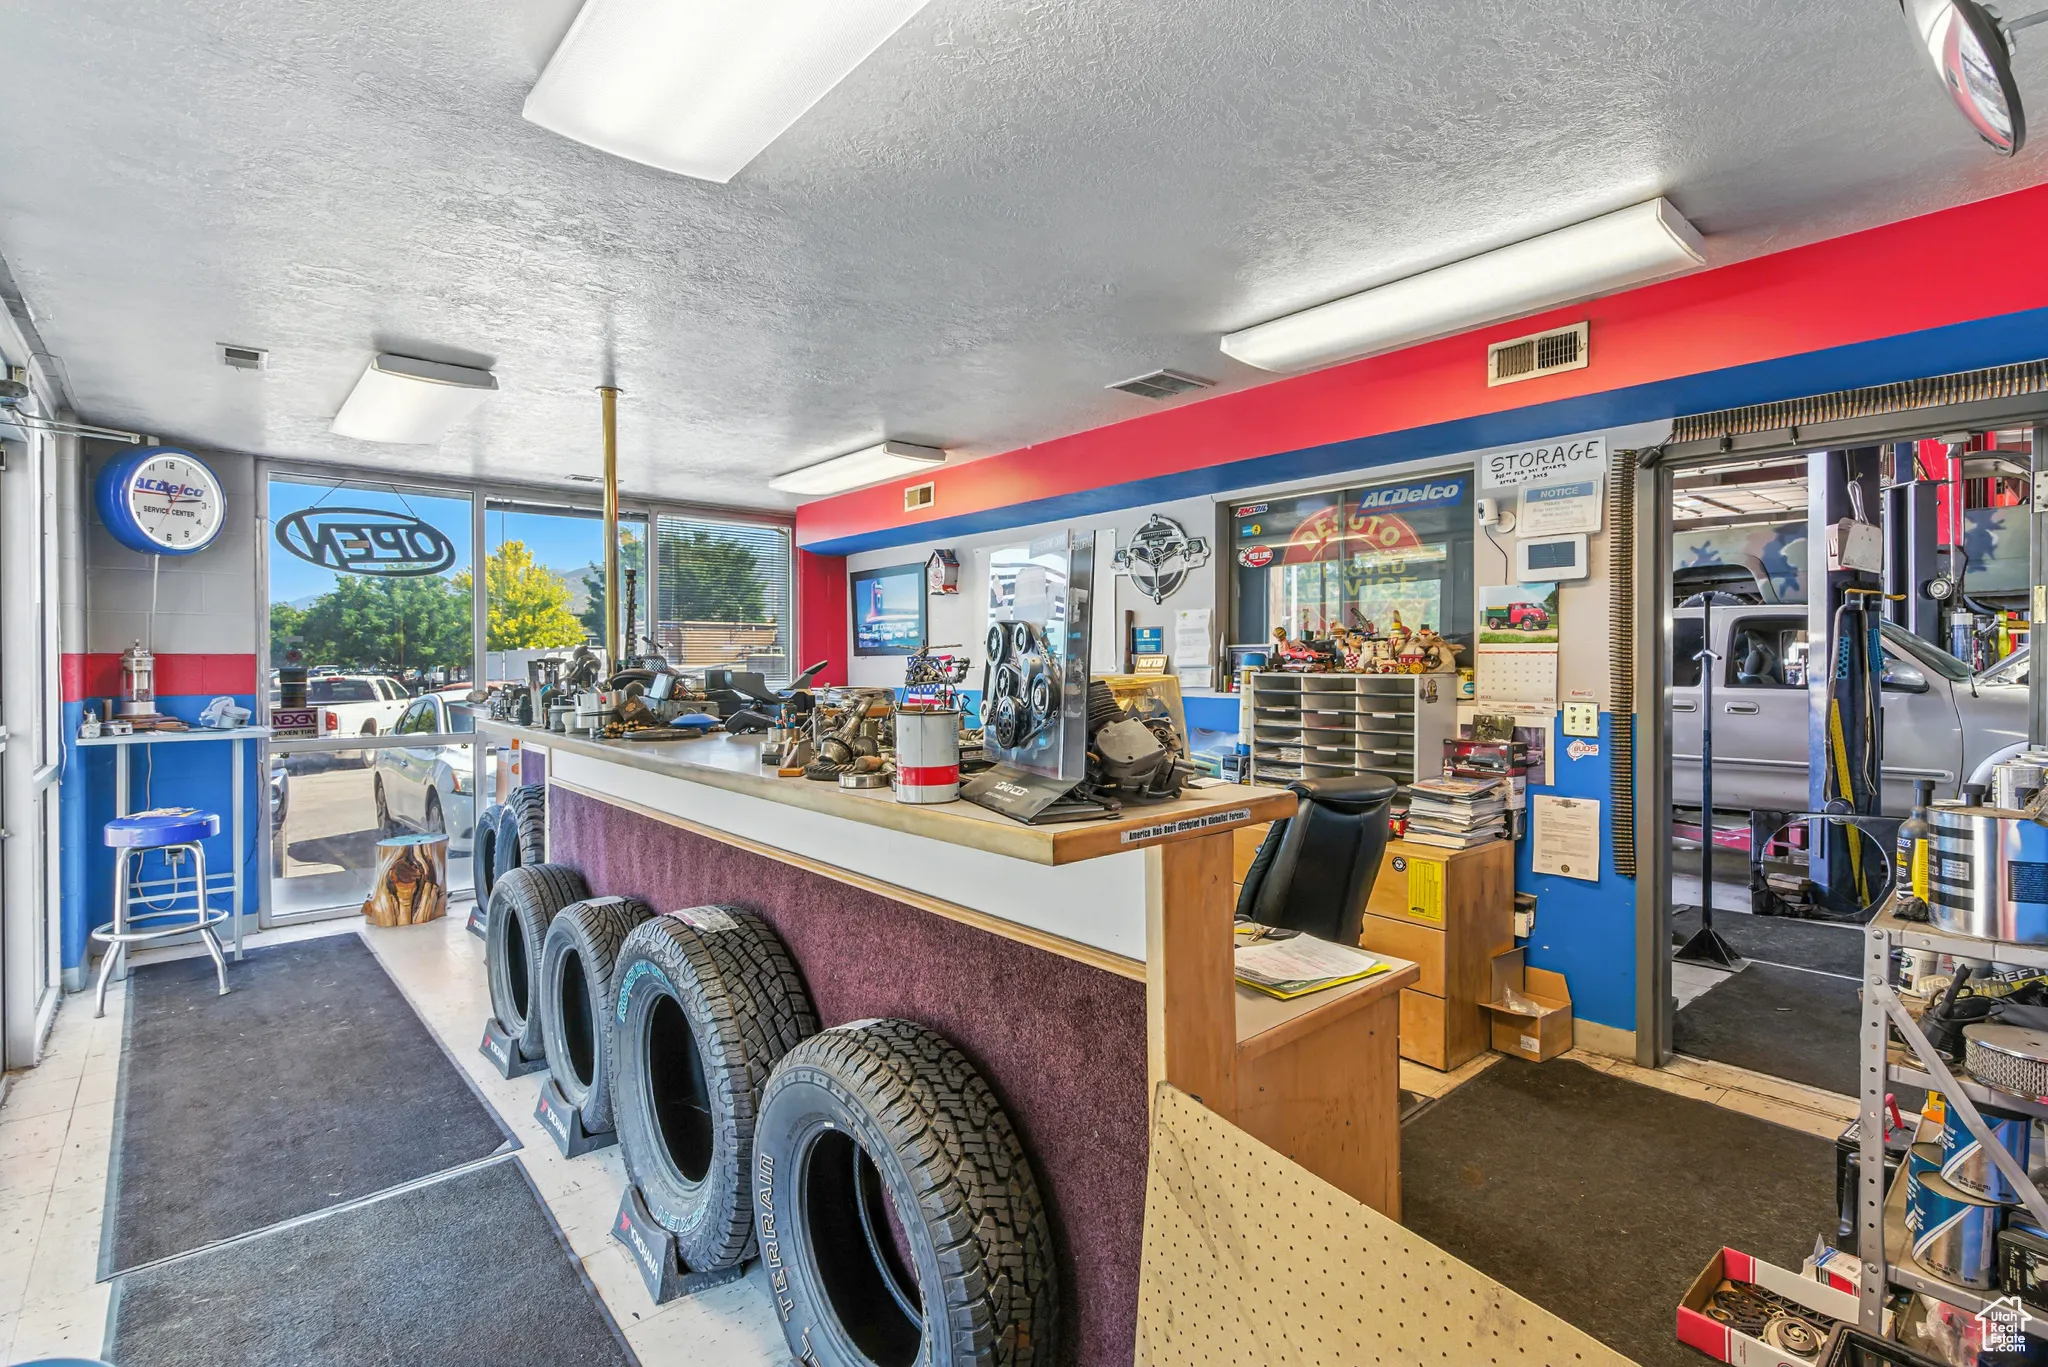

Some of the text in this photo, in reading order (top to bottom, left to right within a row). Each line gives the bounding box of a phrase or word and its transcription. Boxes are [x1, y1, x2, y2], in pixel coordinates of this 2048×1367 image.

[1490, 441, 1599, 473] STORAGE
[135, 477, 205, 497] ACDelco
[1532, 472, 1549, 480] DAYS
[1361, 484, 1459, 509] ACDelco
[1540, 486, 1579, 499] NOTICE
[143, 505, 195, 518] SERVICE CENTER
[1237, 505, 1267, 517] AMSOIL
[1304, 576, 1418, 600] ERVICE
[272, 714, 317, 726] NEXEN
[994, 781, 1029, 797] DAYCO
[1129, 829, 1151, 841] America
[1152, 827, 1163, 836] Has
[1164, 823, 1177, 834] Been
[1177, 819, 1200, 831] Occupied
[1201, 818, 1207, 827] By
[1208, 813, 1228, 825] Globalist
[546, 1105, 569, 1142] YOKOHAMA
[758, 1152, 795, 1323] TERRAIN
[629, 1223, 659, 1280] YOKOHAMA
